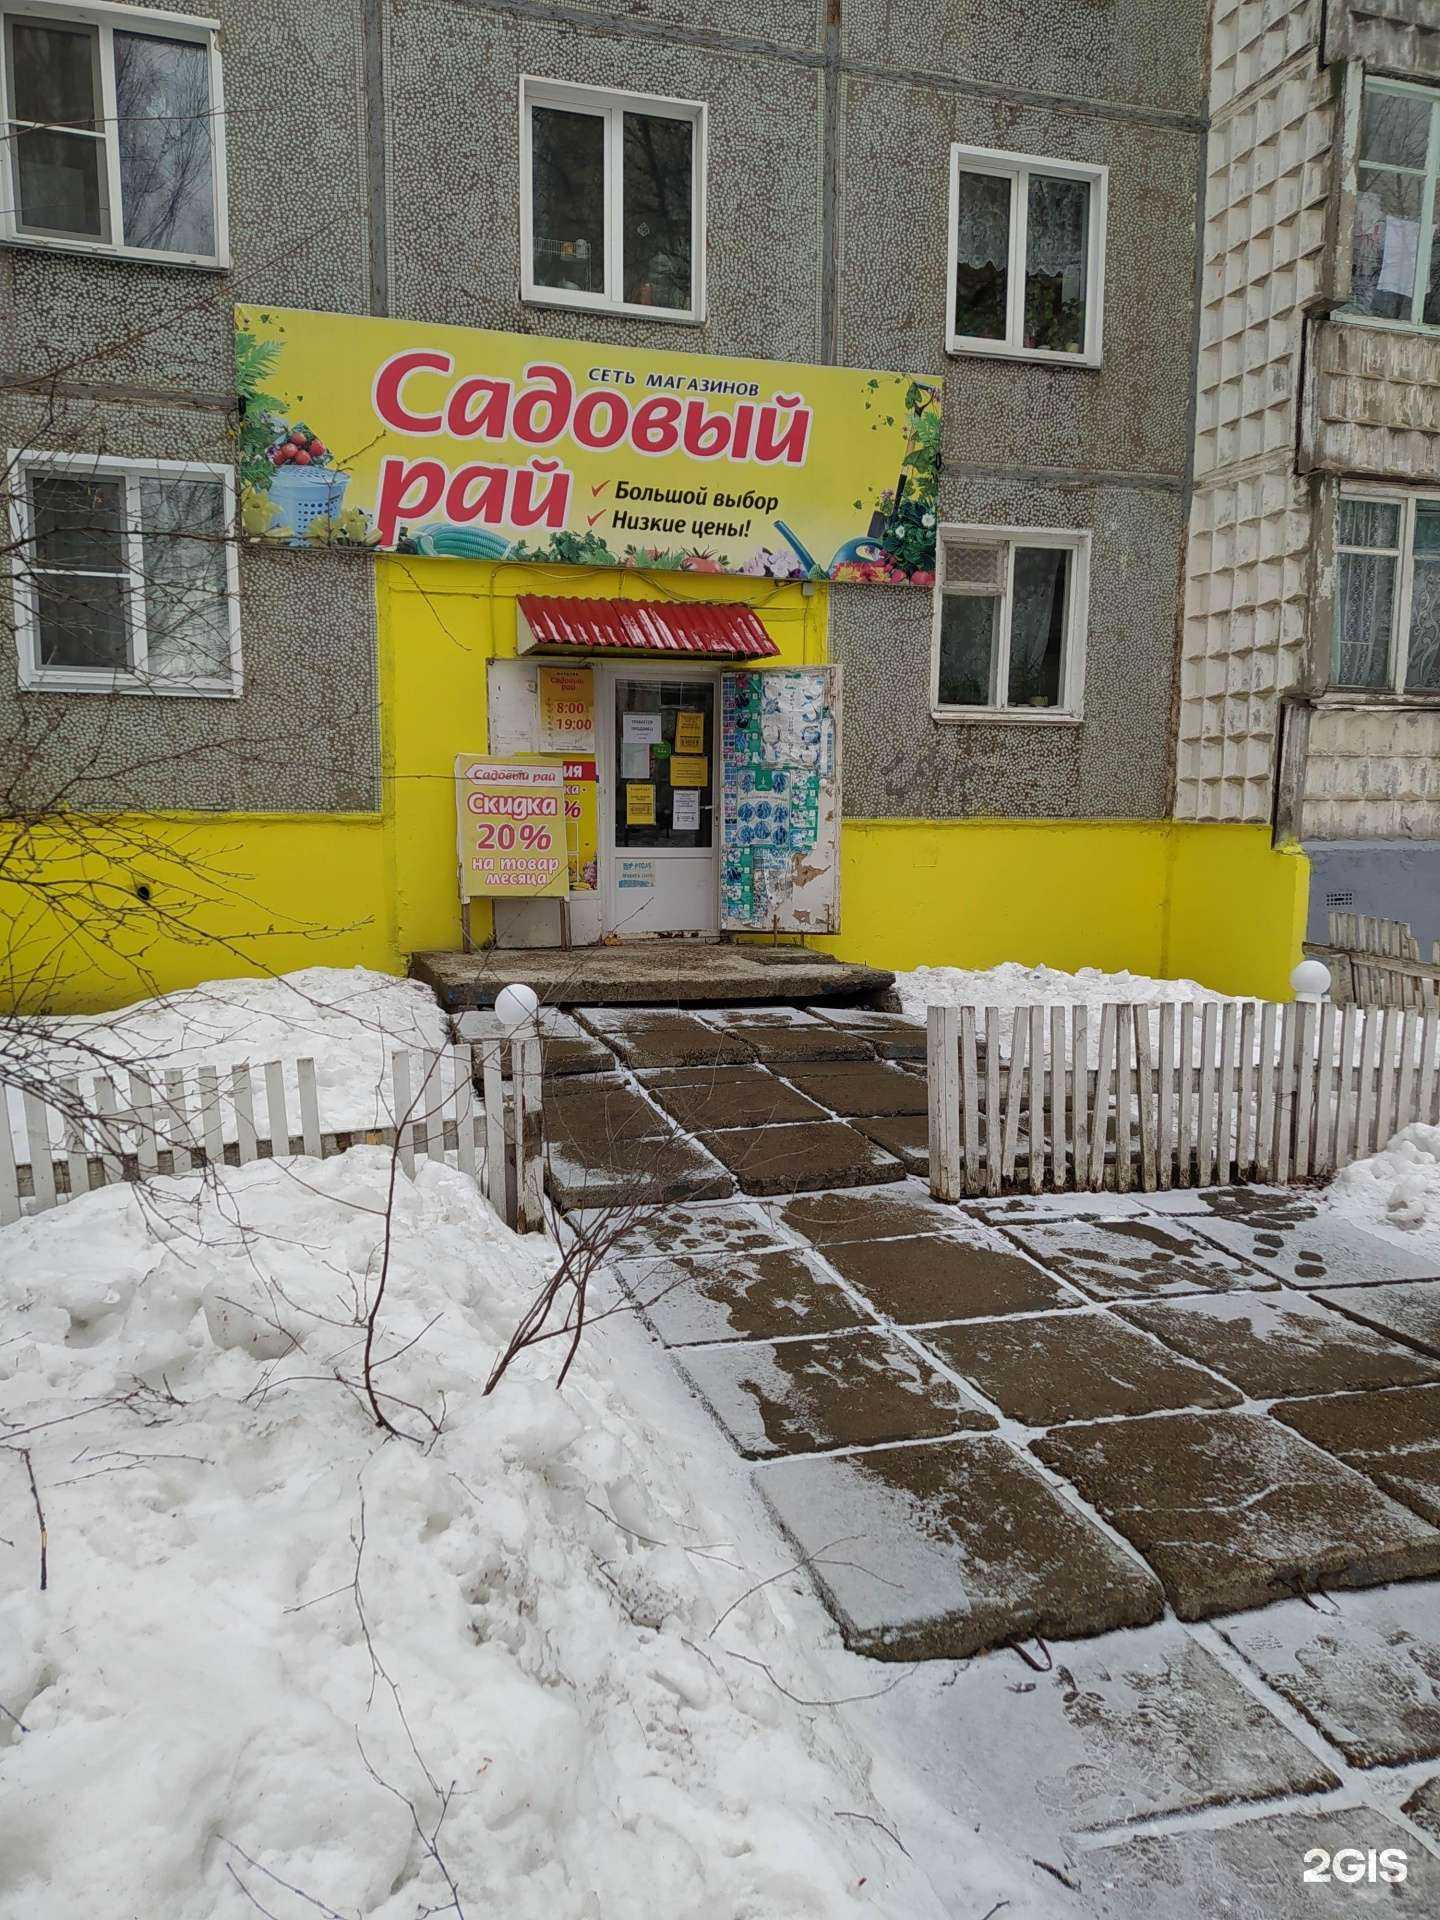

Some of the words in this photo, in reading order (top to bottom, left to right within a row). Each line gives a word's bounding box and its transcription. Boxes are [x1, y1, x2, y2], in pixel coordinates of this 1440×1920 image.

[588, 368, 636, 385] СЕТЬ
[646, 373, 760, 397] МАГАЗИНОВ
[374, 351, 812, 465] Садовый
[376, 457, 571, 547] рай
[615, 480, 708, 506] Большой
[713, 490, 779, 515] выбор
[611, 510, 687, 533] Низкие
[691, 519, 752, 539] цены!
[556, 718, 593, 730] 19:00
[468, 792, 558, 821] Скидка
[477, 823, 553, 851] 20%
[472, 857, 495, 871] на
[500, 857, 560, 874] товар
[486, 873, 548, 887] месяца
